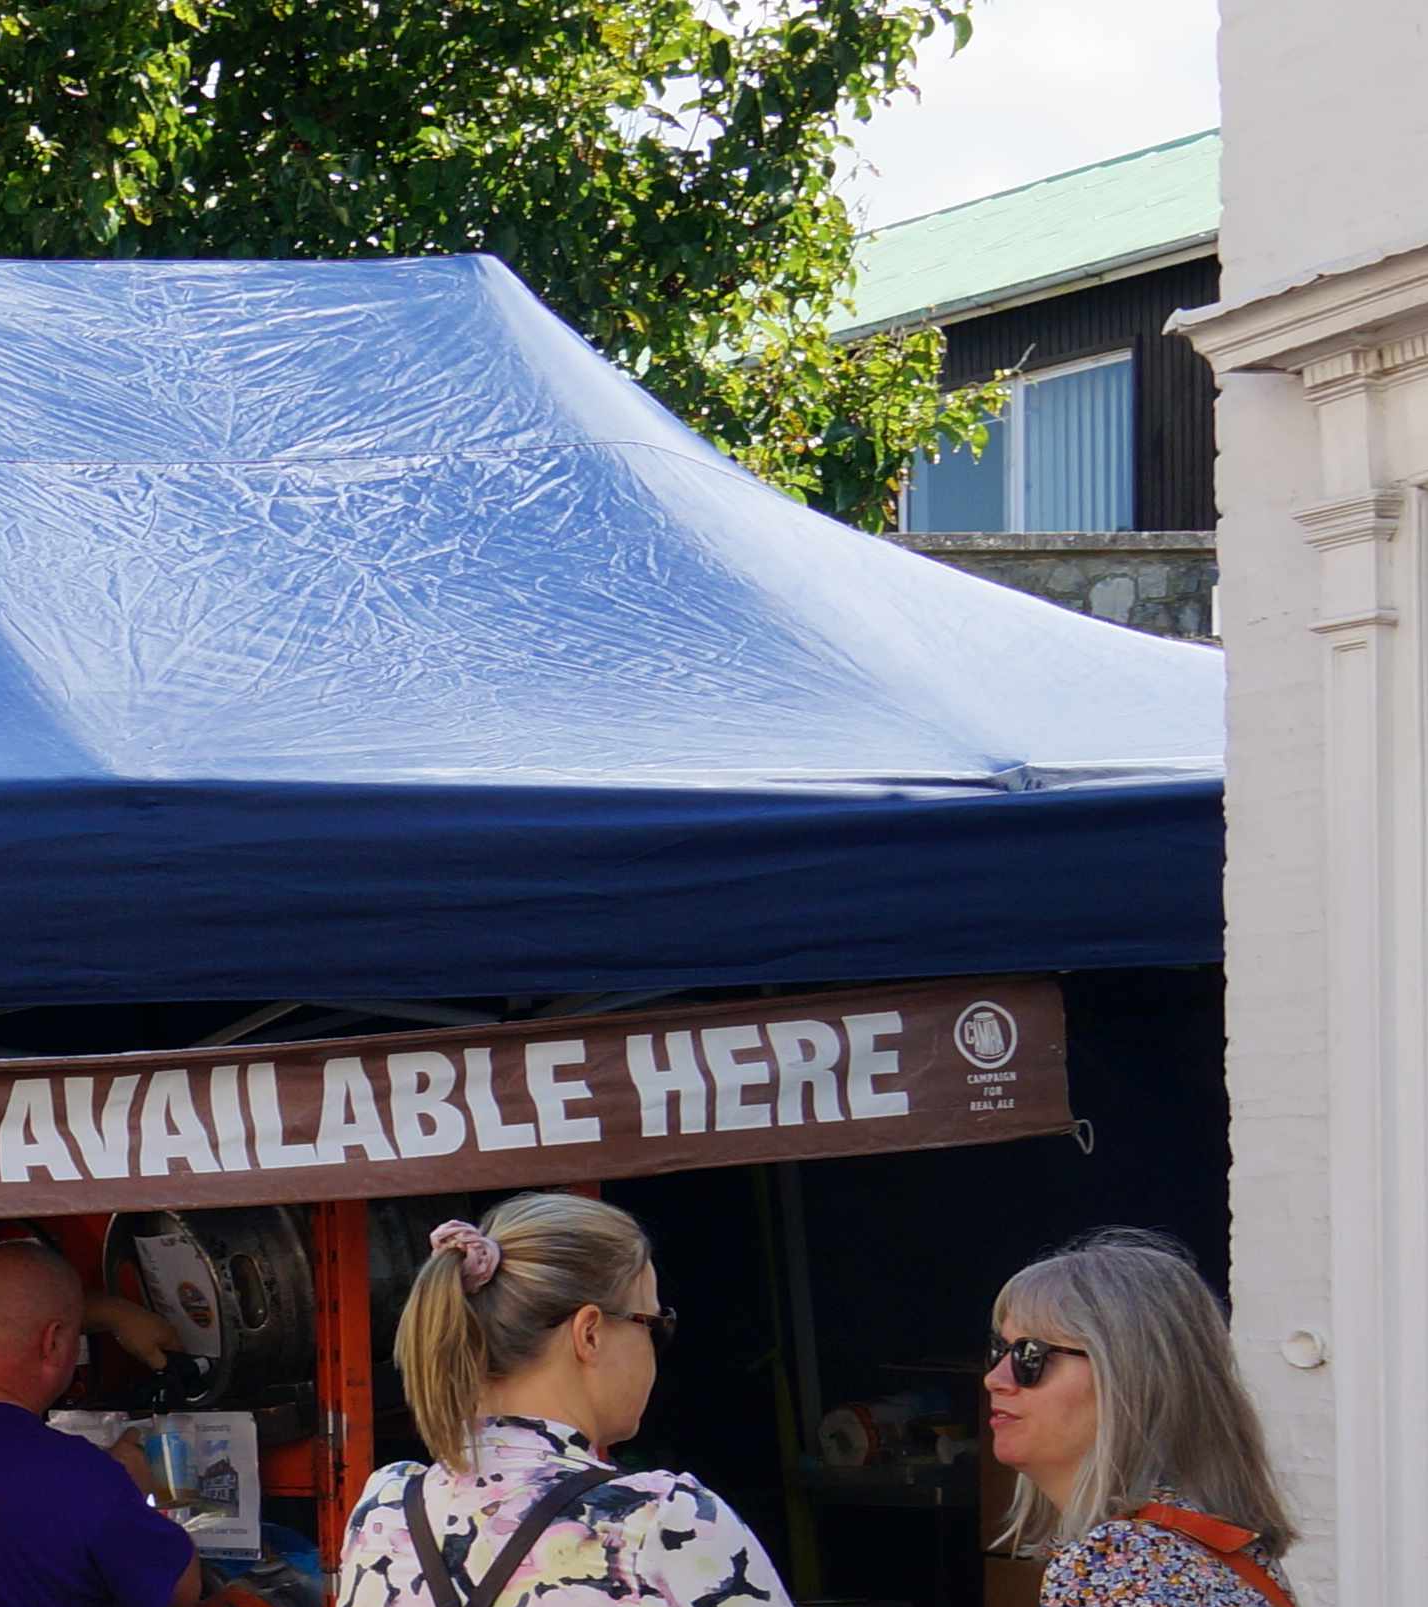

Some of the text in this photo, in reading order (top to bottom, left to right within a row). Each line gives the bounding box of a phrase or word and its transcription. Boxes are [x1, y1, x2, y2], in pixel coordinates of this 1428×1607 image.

[625, 1010, 910, 1138] HERE
[967, 1072, 1017, 1084] CAMPAIGN
[983, 1086, 1003, 1096] FOR
[970, 1098, 1015, 1111] REAL ALE
